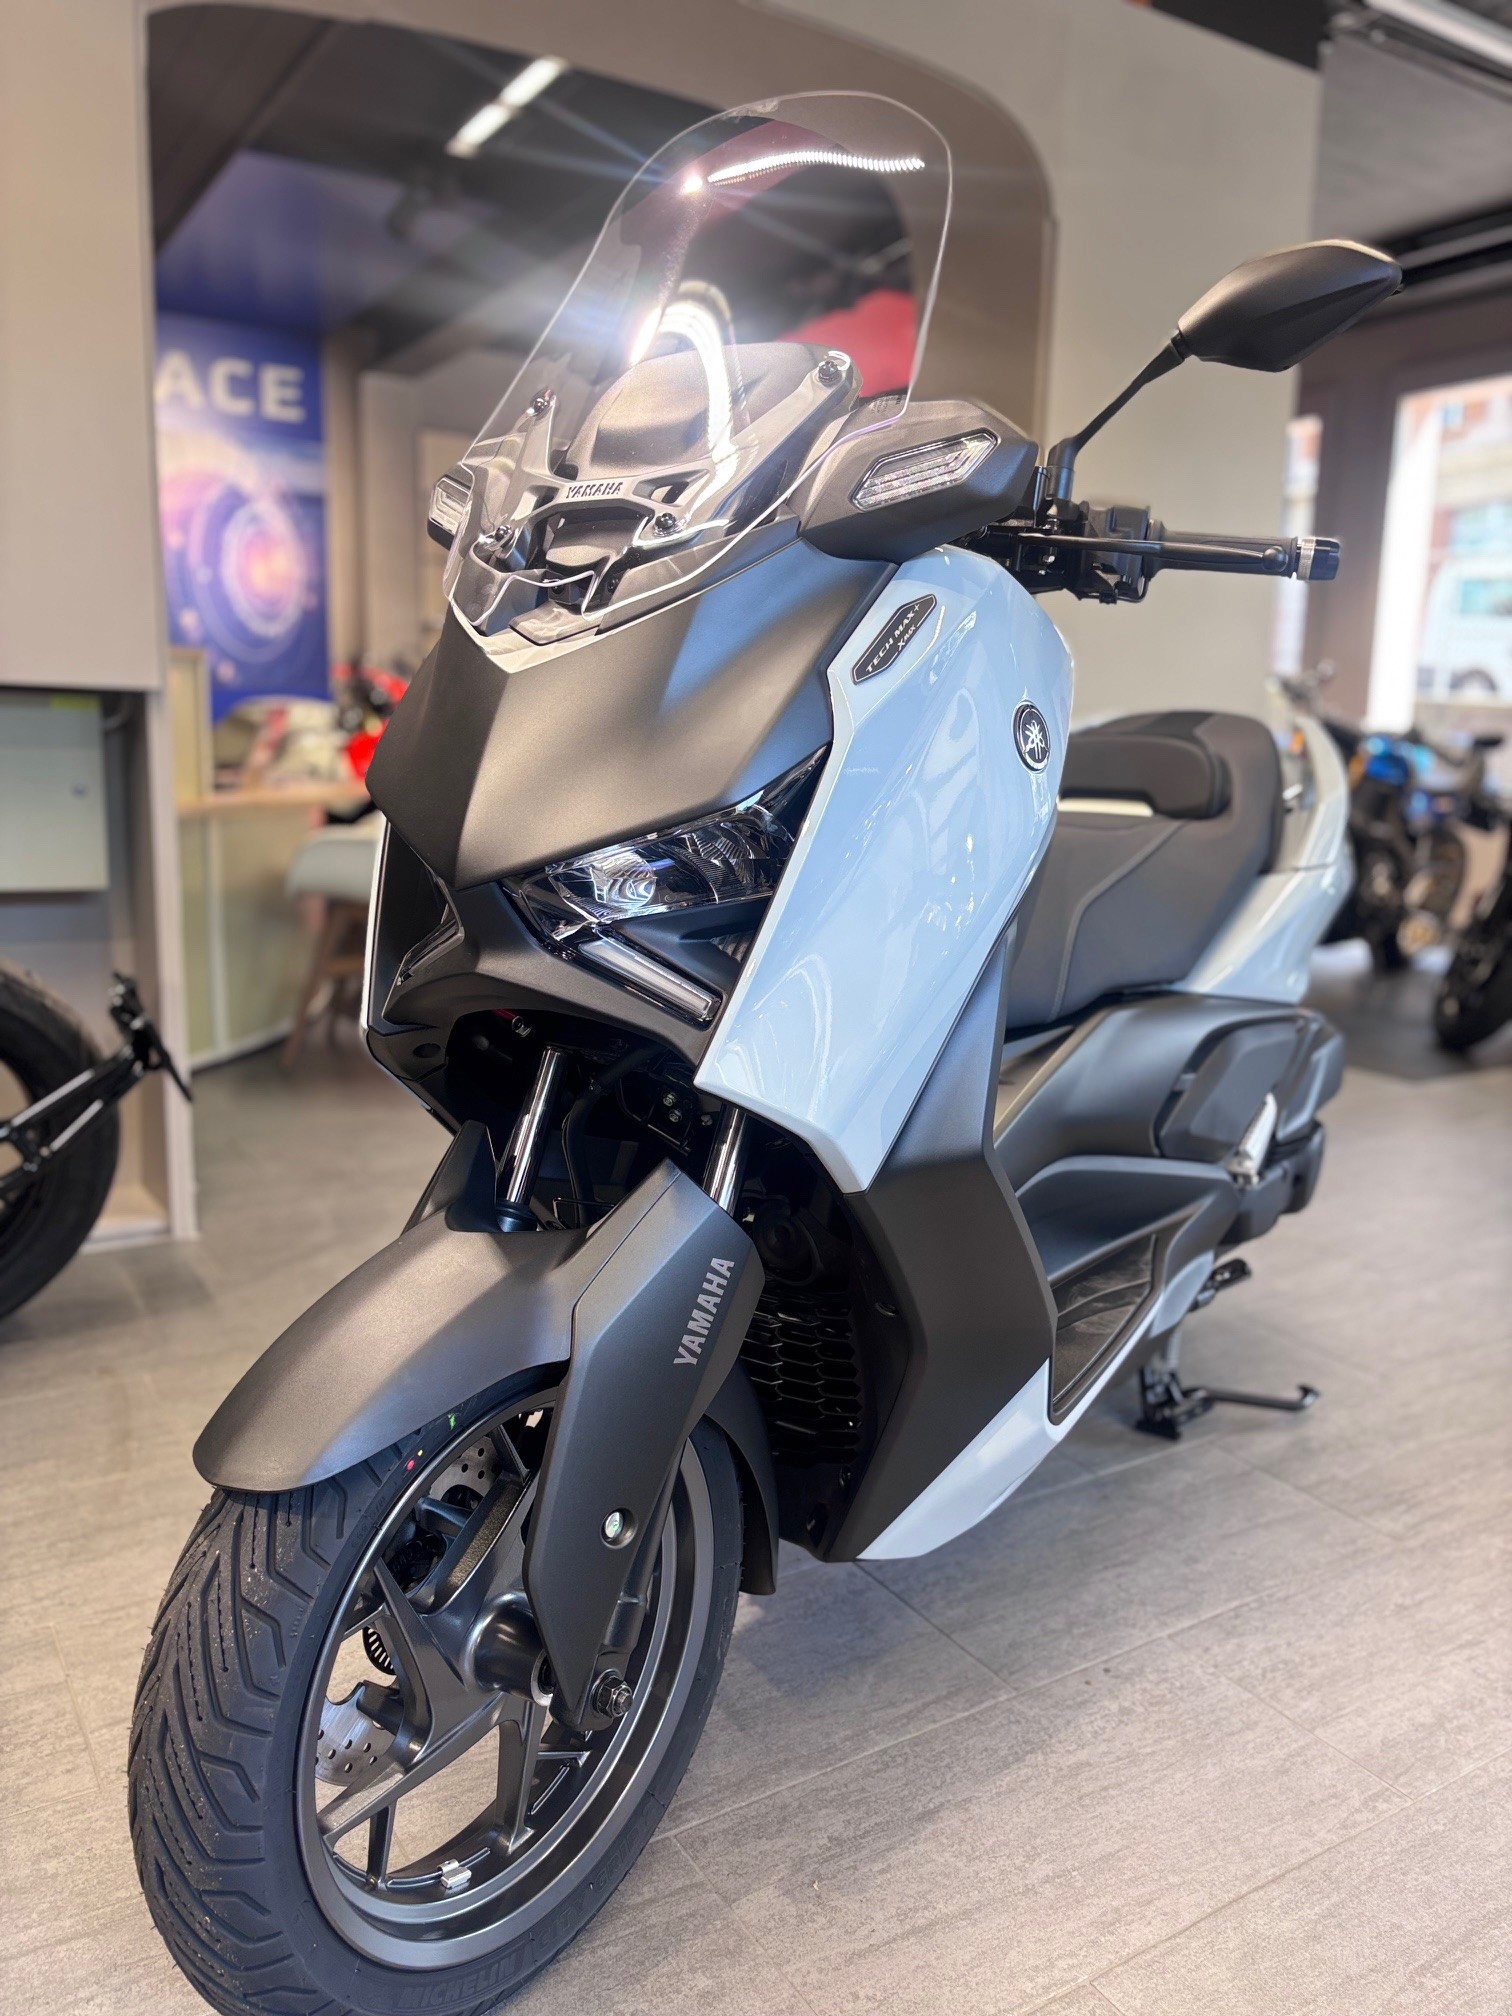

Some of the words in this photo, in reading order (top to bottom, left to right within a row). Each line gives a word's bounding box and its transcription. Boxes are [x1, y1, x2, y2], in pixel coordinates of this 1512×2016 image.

[566, 482, 624, 499] YAMAHA
[865, 637, 894, 673] TECH
[894, 610, 915, 638] MAX
[673, 1257, 735, 1366] YAMAHA
[595, 1826, 640, 1893] GRIP
[397, 1952, 517, 2008] MICHELIN
